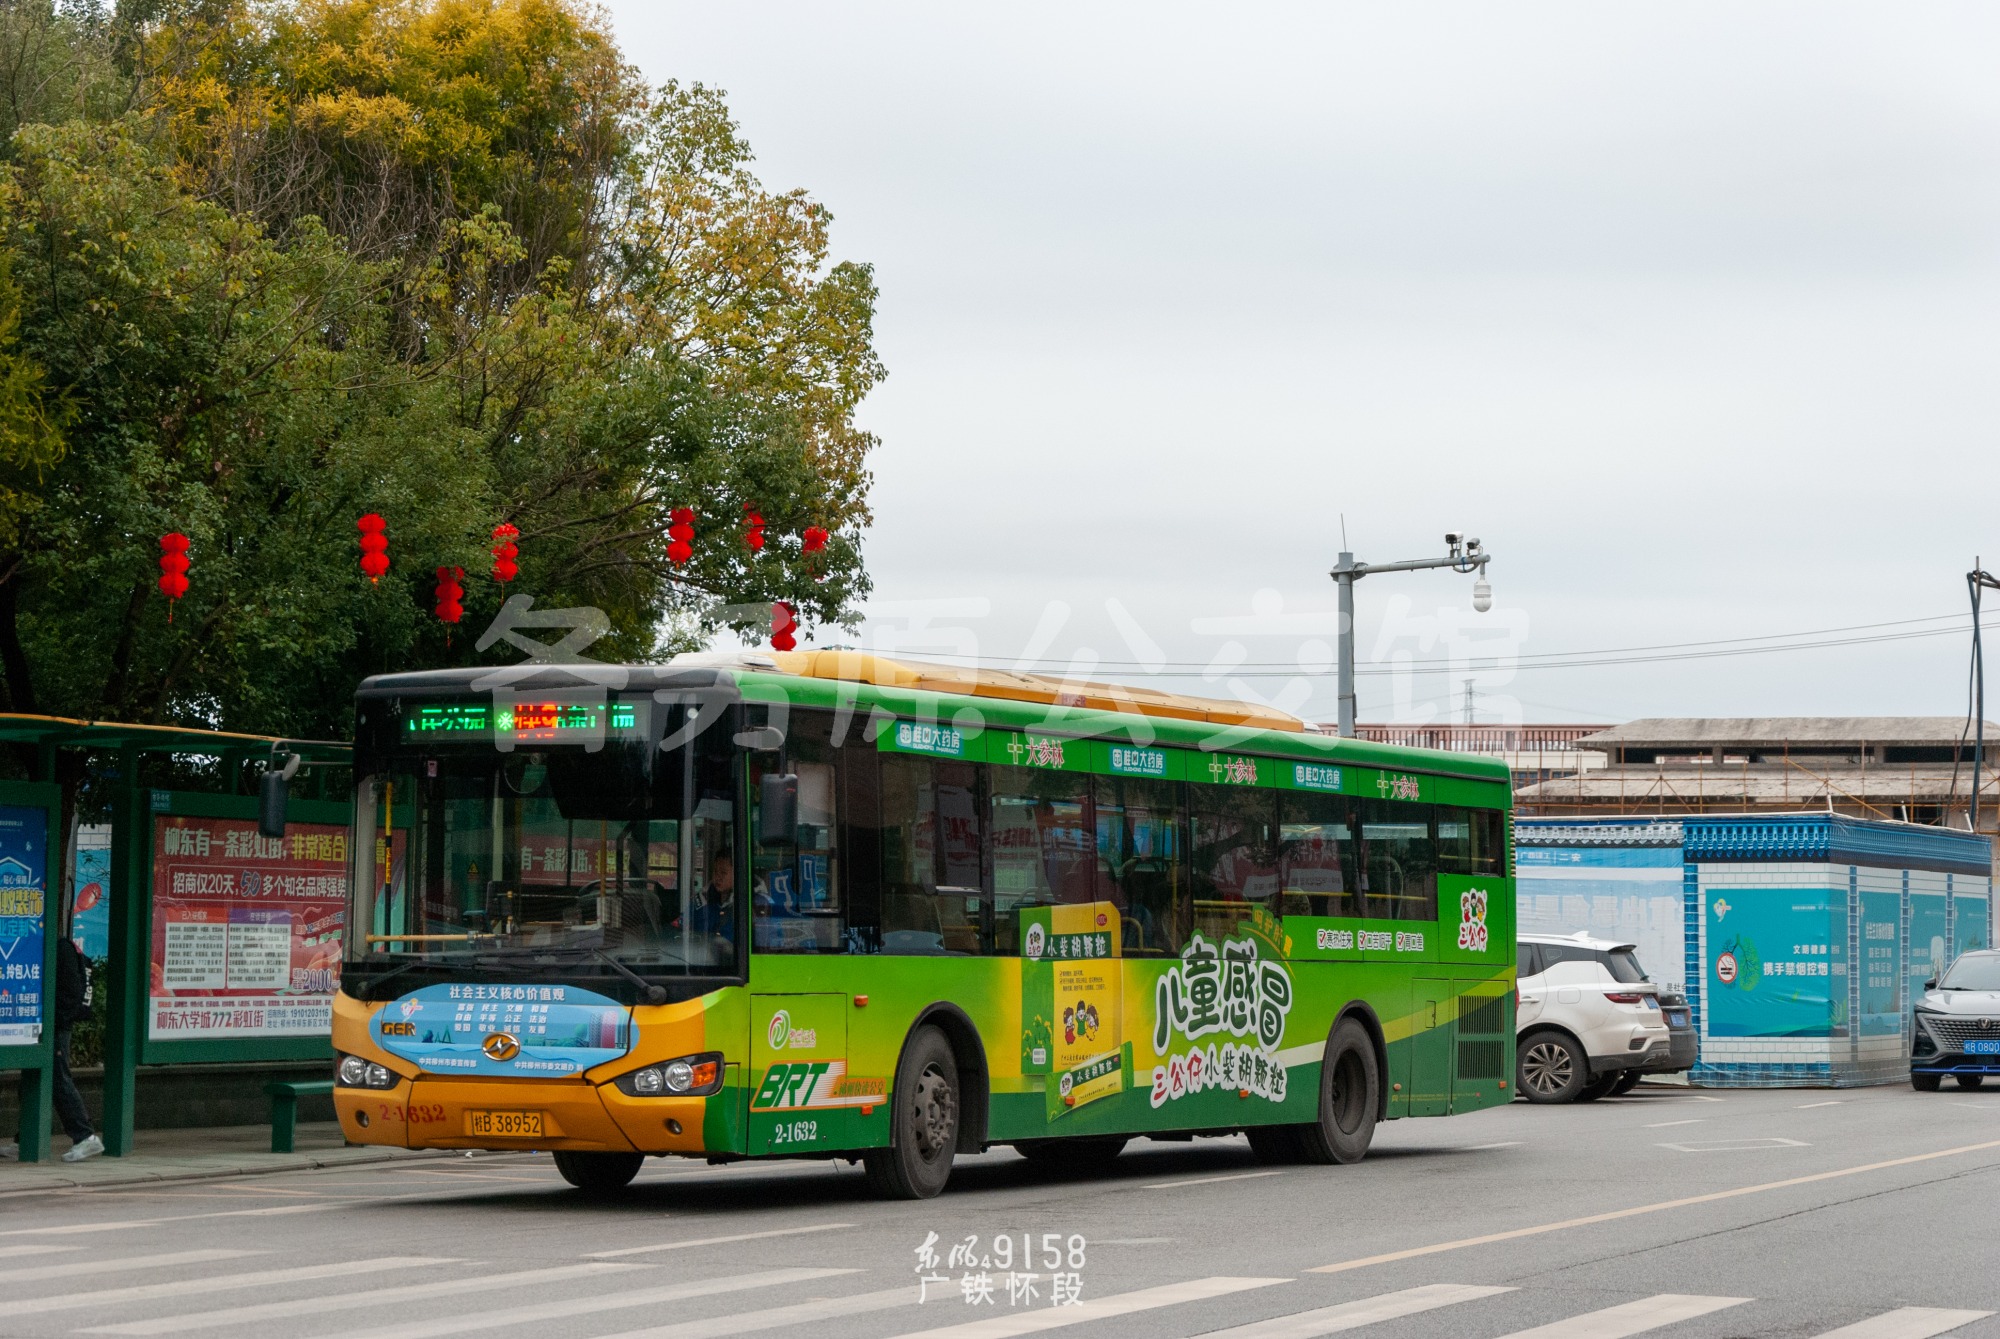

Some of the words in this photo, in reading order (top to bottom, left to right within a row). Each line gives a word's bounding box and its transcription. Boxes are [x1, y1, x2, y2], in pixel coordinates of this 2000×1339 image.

[912, 725, 960, 749] 桂中大药房
[1025, 737, 1065, 769] 大参林
[1123, 749, 1163, 769] 桂中大药房
[1224, 757, 1258, 785] 大参林
[1305, 765, 1340, 785] 桂中大药房
[1390, 775, 1420, 801] 大参林
[1047, 933, 1106, 958] 小柴胡颗粒
[1326, 929, 1353, 949] 寒热往来
[1366, 931, 1392, 950] 口苦咽干
[1404, 933, 1424, 951] 胃口差
[1459, 924, 1487, 952] 三公仔
[1793, 944, 1828, 955] 文明健康
[303, 968, 332, 991] 2000
[1763, 962, 1829, 976] 携手禁烟控烟
[449, 985, 565, 1001] 社会主义核心价值观
[1155, 937, 1291, 1052] 儿童感冒
[455, 1012, 472, 1022] 自由
[479, 1013, 496, 1022] 平等
[504, 1013, 522, 1023] 公正
[529, 1014, 547, 1024] 法治
[457, 1003, 474, 1012] 富强
[481, 1003, 498, 1012] 民主
[506, 1003, 523, 1013] 文明
[531, 1004, 549, 1013] 和谐
[157, 1010, 264, 1029] 柳东大学城772彩虹街
[454, 1022, 471, 1032] 爱国
[479, 1023, 496, 1033] 敬业
[504, 1023, 521, 1034] 诚信
[529, 1024, 546, 1035] 友善
[418, 1056, 477, 1068] 中共柳州市委宣传部
[514, 1060, 575, 1071] 中共柳州市委文明办
[753, 1062, 830, 1109] BRT
[774, 1120, 818, 1144] 2-1632
